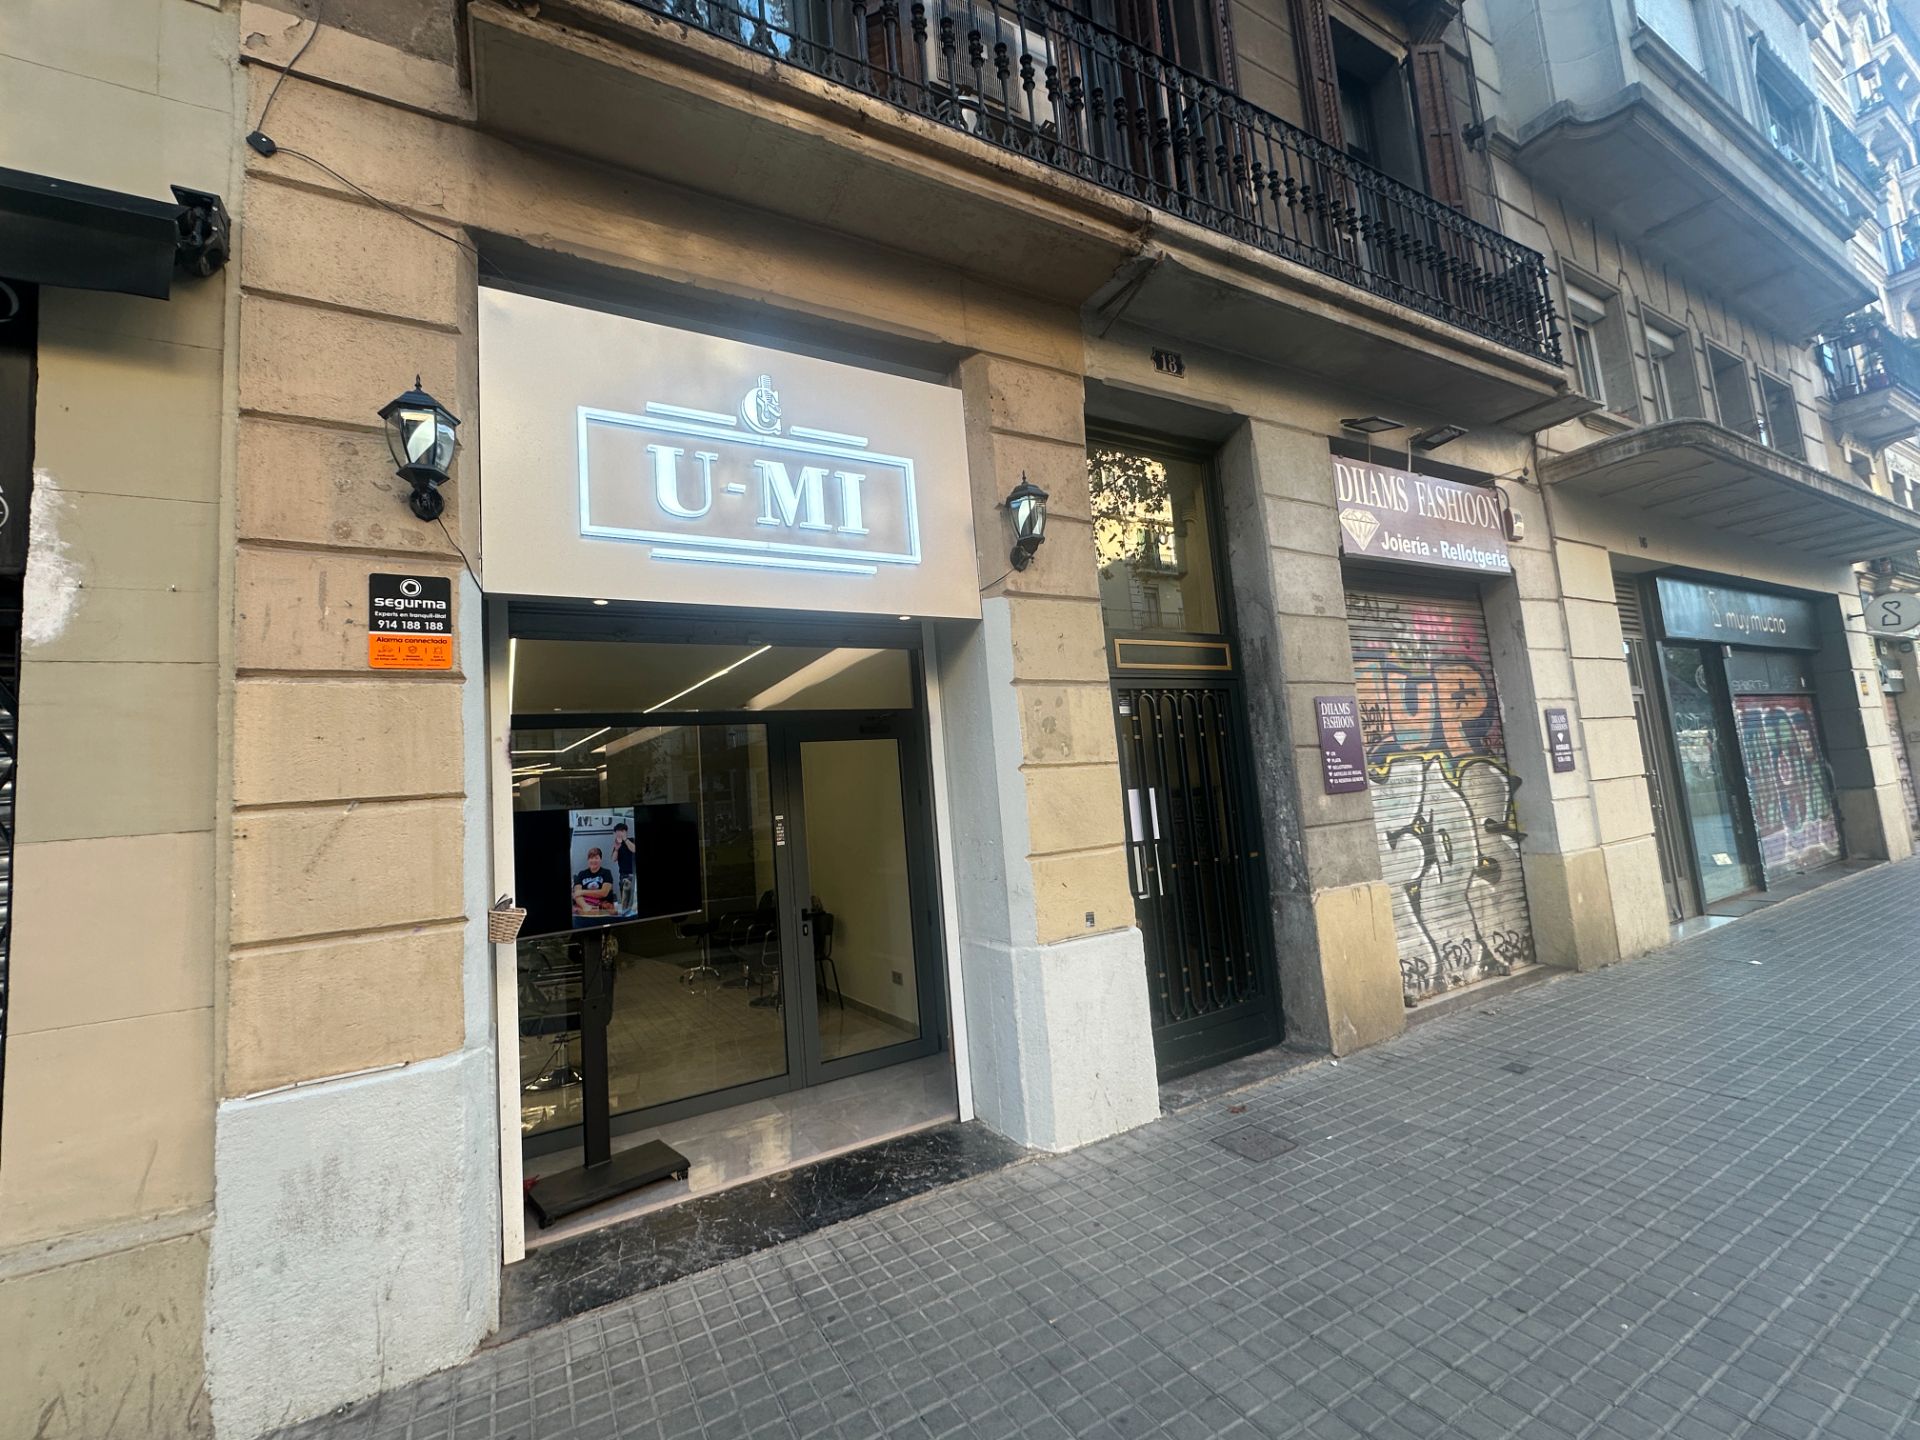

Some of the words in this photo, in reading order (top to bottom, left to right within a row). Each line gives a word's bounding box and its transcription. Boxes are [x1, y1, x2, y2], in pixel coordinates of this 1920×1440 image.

[1161, 353, 1178, 373] 18
[646, 444, 869, 535] U-MI
[1334, 463, 1409, 513] DIIAMS
[1415, 481, 1501, 530] FASHIOON
[1381, 532, 1430, 556] Joiería
[1440, 541, 1509, 568] Rellotgeria
[374, 597, 447, 610] segurma
[378, 619, 398, 629] 914
[401, 621, 421, 630] 188
[424, 622, 444, 631] 188
[376, 636, 403, 644] Alarma
[1321, 702, 1351, 716] DIIAMS
[1322, 715, 1355, 729] FASHIOON
